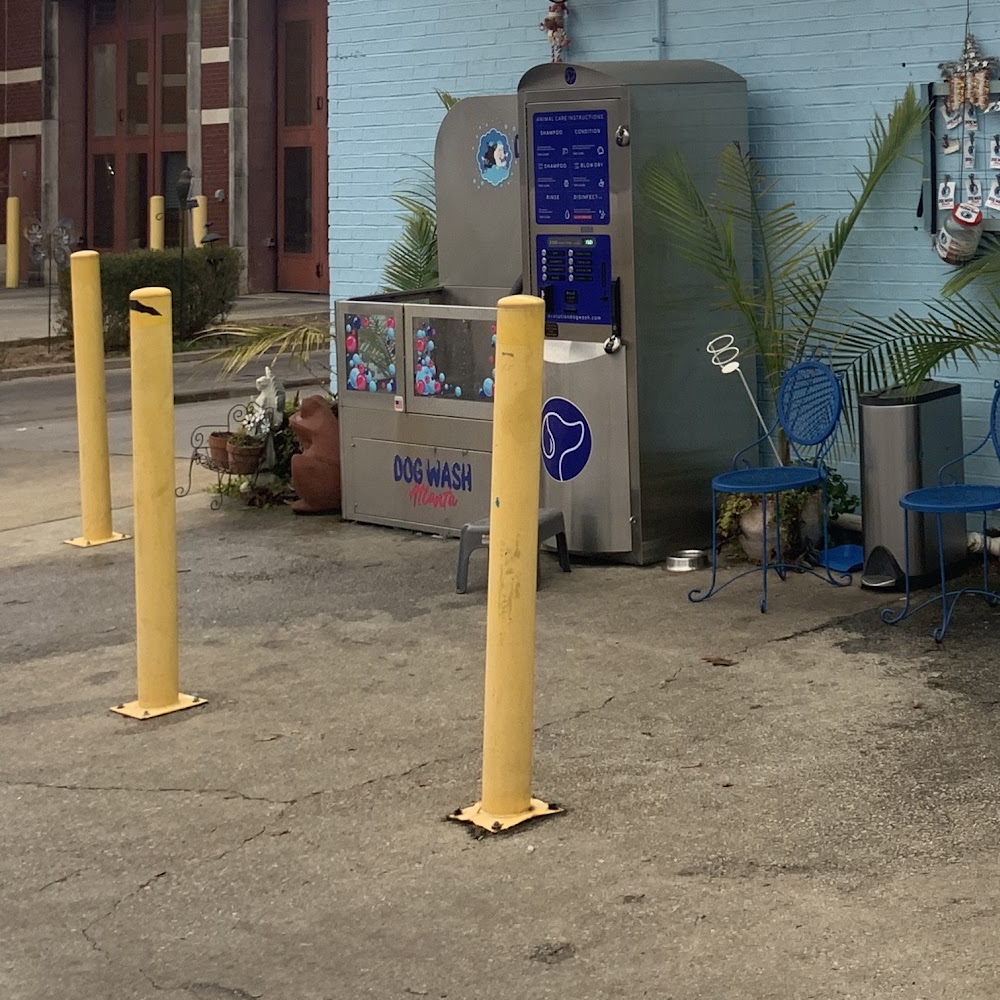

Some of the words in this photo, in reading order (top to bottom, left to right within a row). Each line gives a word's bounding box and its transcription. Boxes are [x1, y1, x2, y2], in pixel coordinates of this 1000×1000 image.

[393, 455, 423, 485] DOG
[426, 457, 472, 492] WASH
[408, 484, 458, 508] Atlanta
